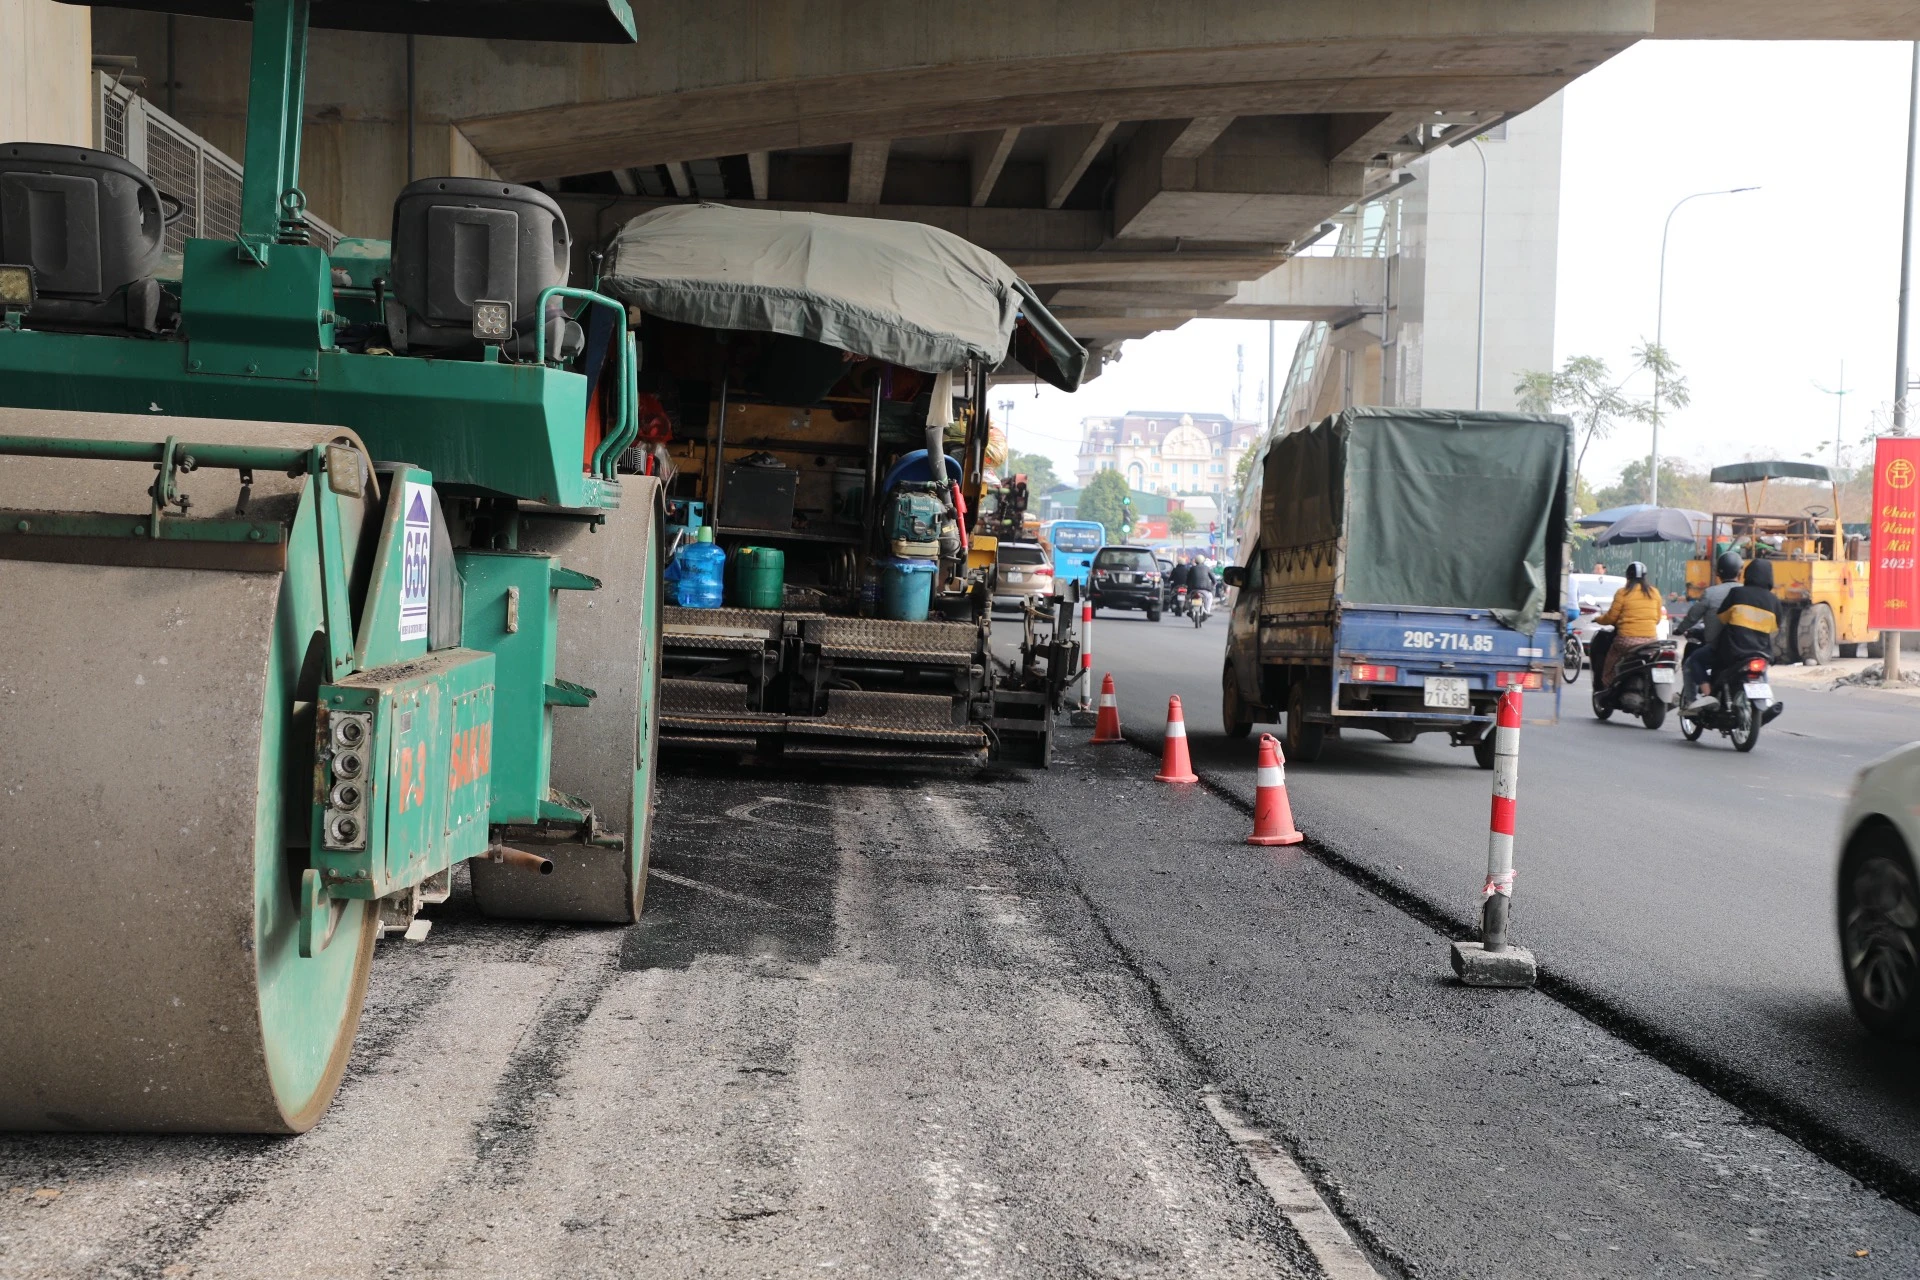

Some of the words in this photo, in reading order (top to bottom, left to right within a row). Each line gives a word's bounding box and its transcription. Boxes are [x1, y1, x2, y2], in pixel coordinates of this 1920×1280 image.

[405, 531, 428, 598] 656
[1881, 558, 1914, 569] 2023
[1403, 631, 1494, 651] 29C-714.85
[1435, 678, 1458, 691] 29C
[1426, 692, 1467, 706] 714.85
